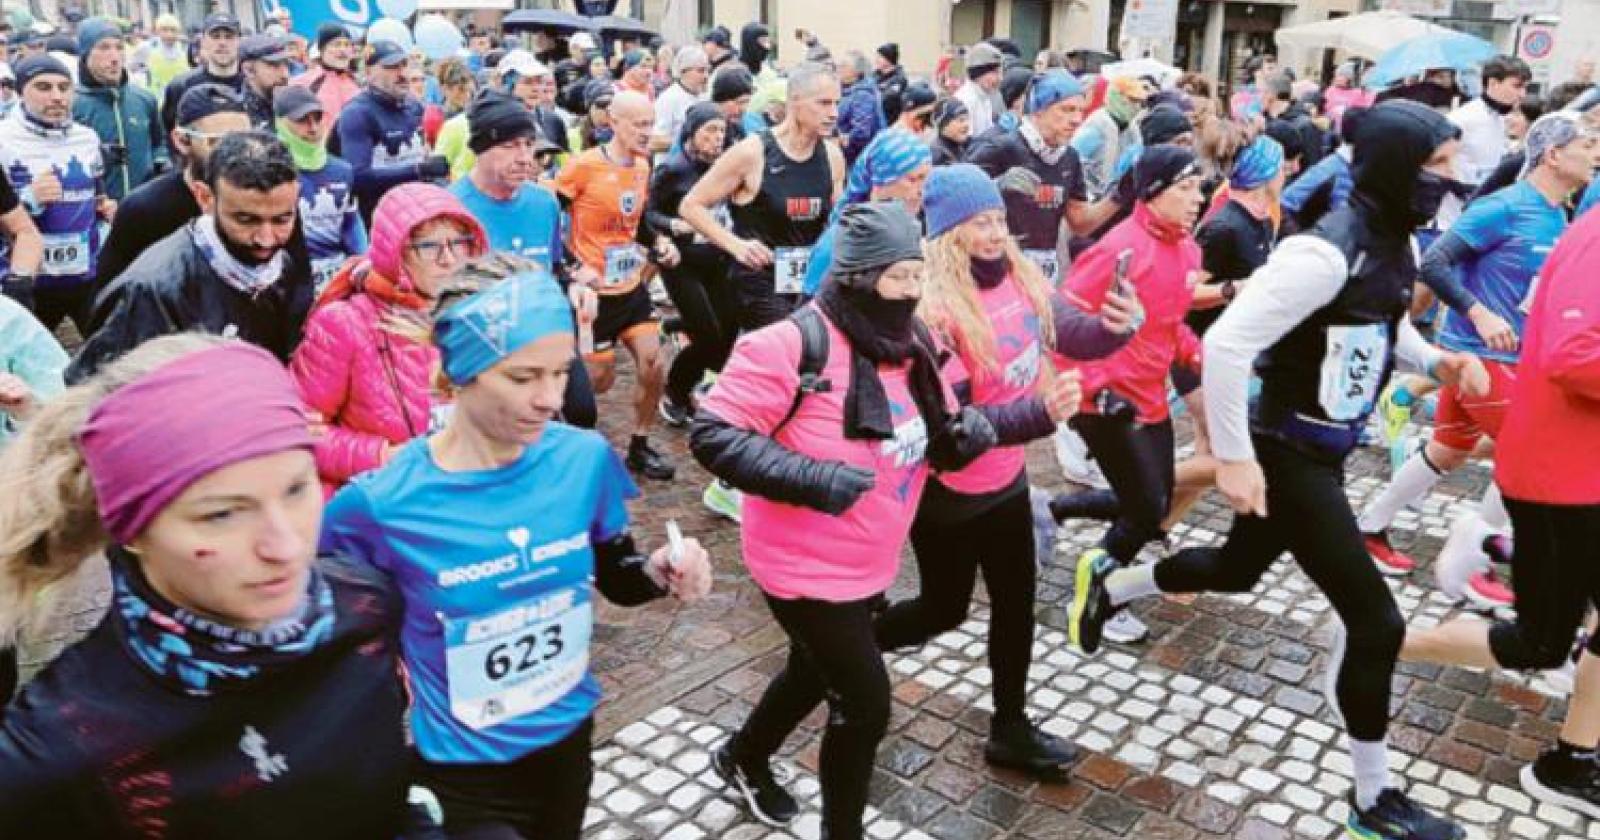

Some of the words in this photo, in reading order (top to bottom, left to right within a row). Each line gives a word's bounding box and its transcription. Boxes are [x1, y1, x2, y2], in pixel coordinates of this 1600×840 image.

[1347, 347, 1373, 400] 294
[438, 553, 519, 587] BROOKS
[485, 623, 564, 681] 623
